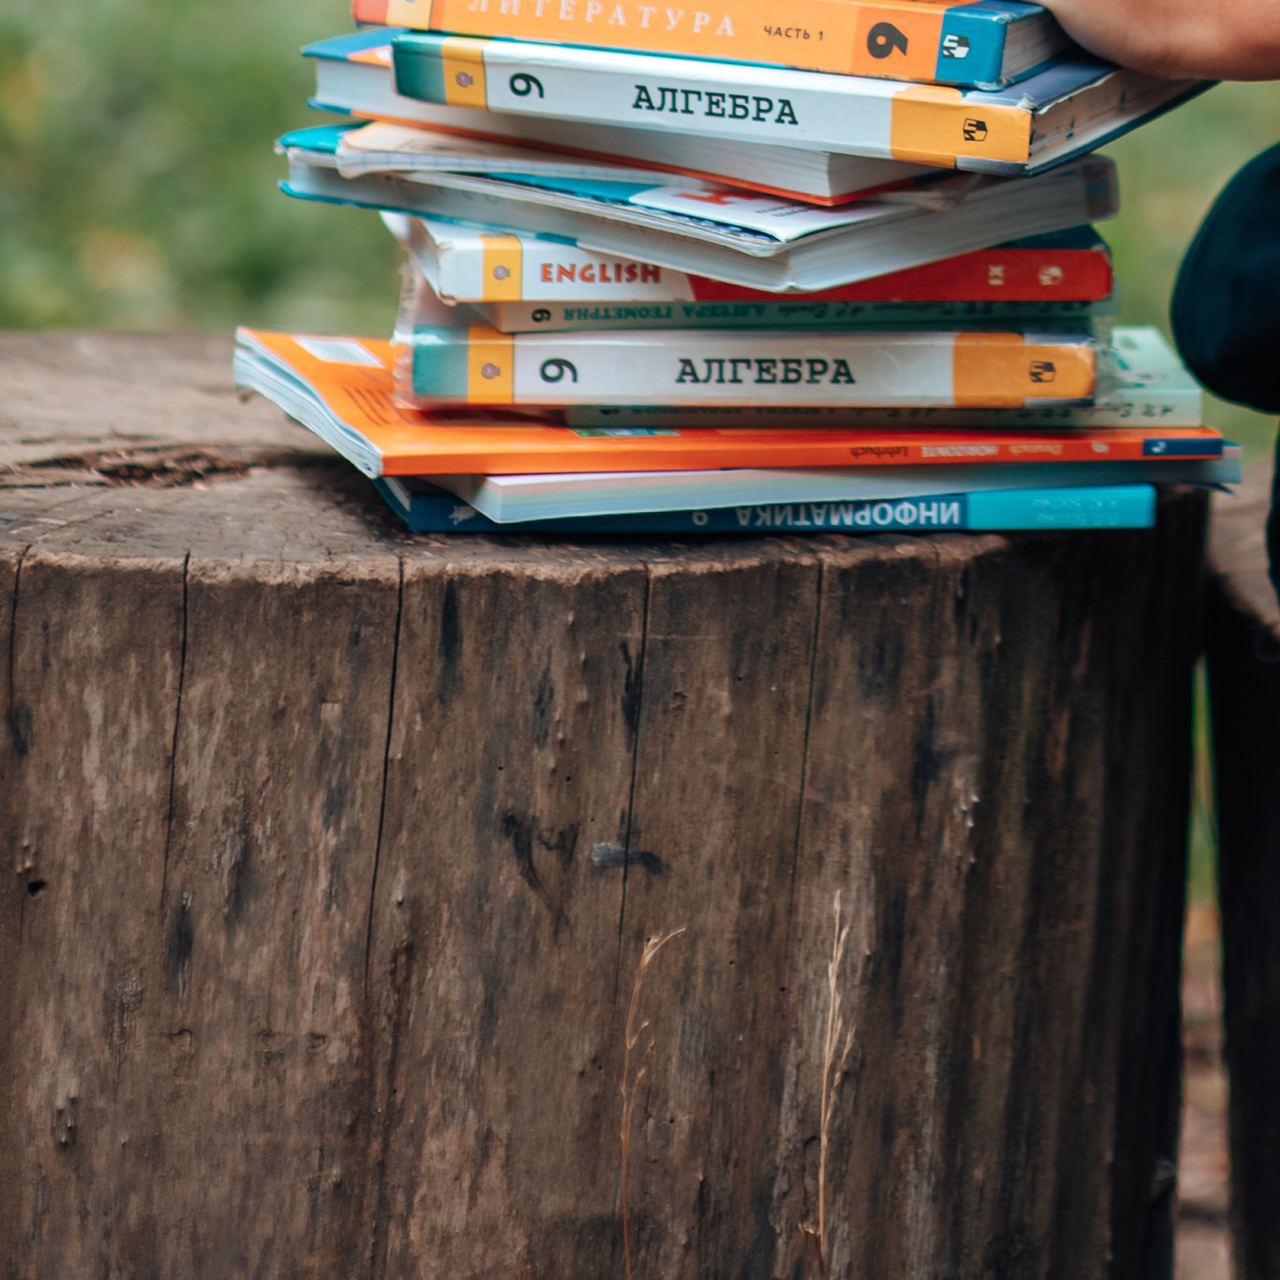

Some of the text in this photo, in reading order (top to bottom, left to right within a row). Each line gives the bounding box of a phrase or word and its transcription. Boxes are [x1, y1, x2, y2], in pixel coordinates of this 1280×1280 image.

[763, 25, 810, 40] ЧАСТЬ
[818, 30, 824, 42] 1
[632, 84, 799, 125] АЛГЕБРА
[540, 263, 661, 284] ENGLISH
[563, 305, 673, 321] ГЕОМЕТРИЯ
[675, 358, 856, 384] АЛГЕБРА
[850, 445, 908, 458] Lehrbuch
[736, 502, 961, 526] ИНФОРМАТИКА
